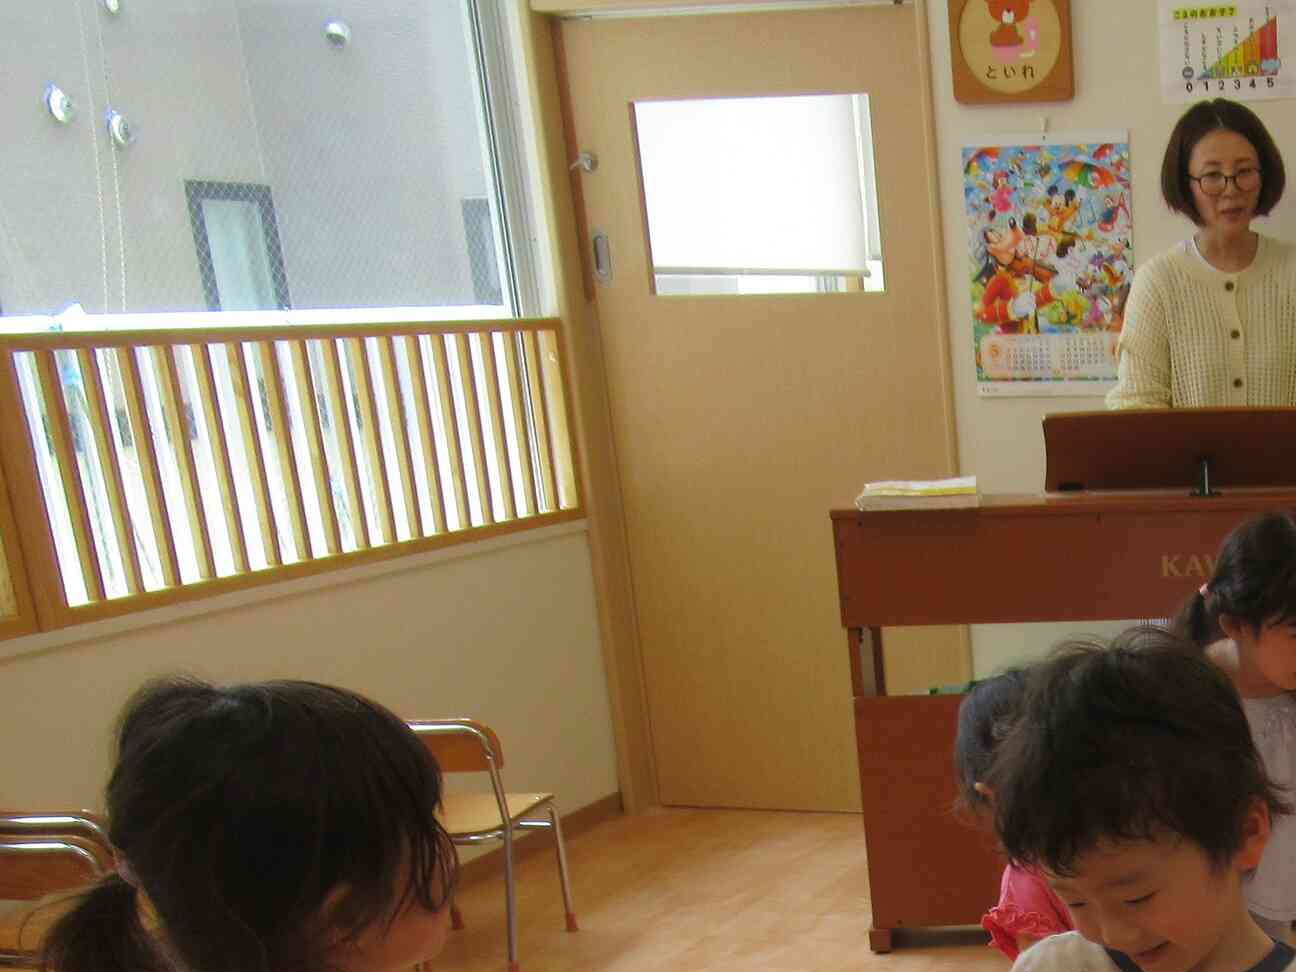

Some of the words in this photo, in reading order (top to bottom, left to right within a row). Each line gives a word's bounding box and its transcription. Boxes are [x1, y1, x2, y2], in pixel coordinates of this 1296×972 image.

[986, 65, 1034, 80] といれ
[1186, 82, 1193, 93] 0
[1218, 80, 1225, 91] 2
[1233, 80, 1241, 90] 3
[1249, 79, 1256, 89] 4
[1267, 77, 1275, 88] 5
